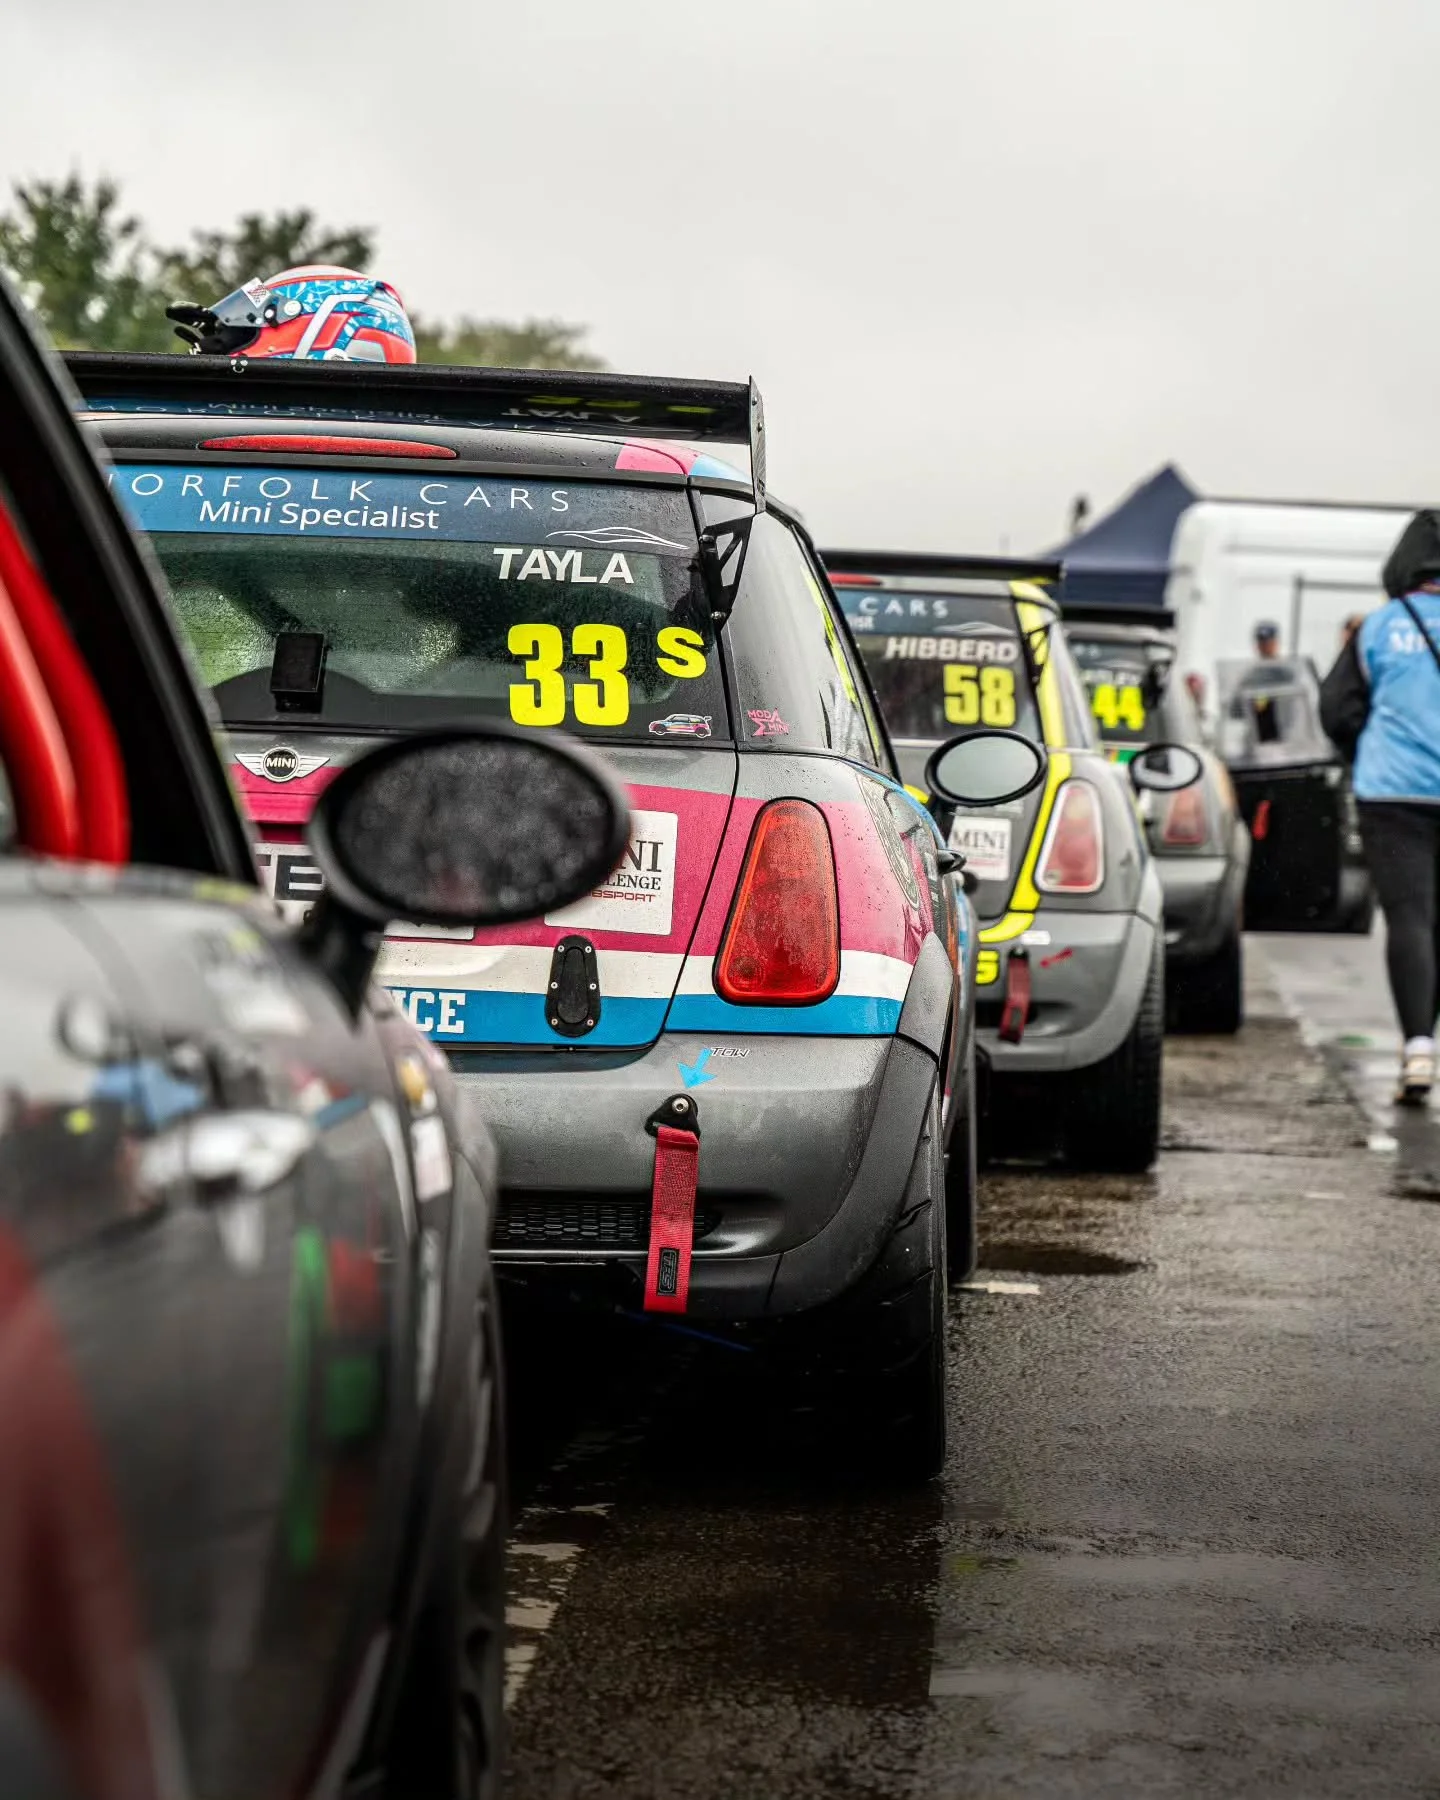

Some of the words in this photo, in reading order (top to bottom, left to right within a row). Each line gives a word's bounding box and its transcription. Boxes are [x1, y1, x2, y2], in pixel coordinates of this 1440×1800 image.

[106, 472, 373, 502] ORFOLK
[418, 483, 570, 513] CARS
[199, 500, 272, 525] Mini
[279, 502, 440, 531] Specialist
[493, 547, 635, 585] TAYLA
[858, 596, 949, 619] CARS
[885, 635, 1019, 664] HIBBERD
[507, 623, 630, 727] 33
[943, 663, 1016, 728] 58
[1092, 682, 1146, 732] 44
[266, 757, 297, 769] MINI
[617, 839, 664, 873] NI
[591, 889, 657, 903] BSPORT
[711, 1046, 750, 1059] TOW
